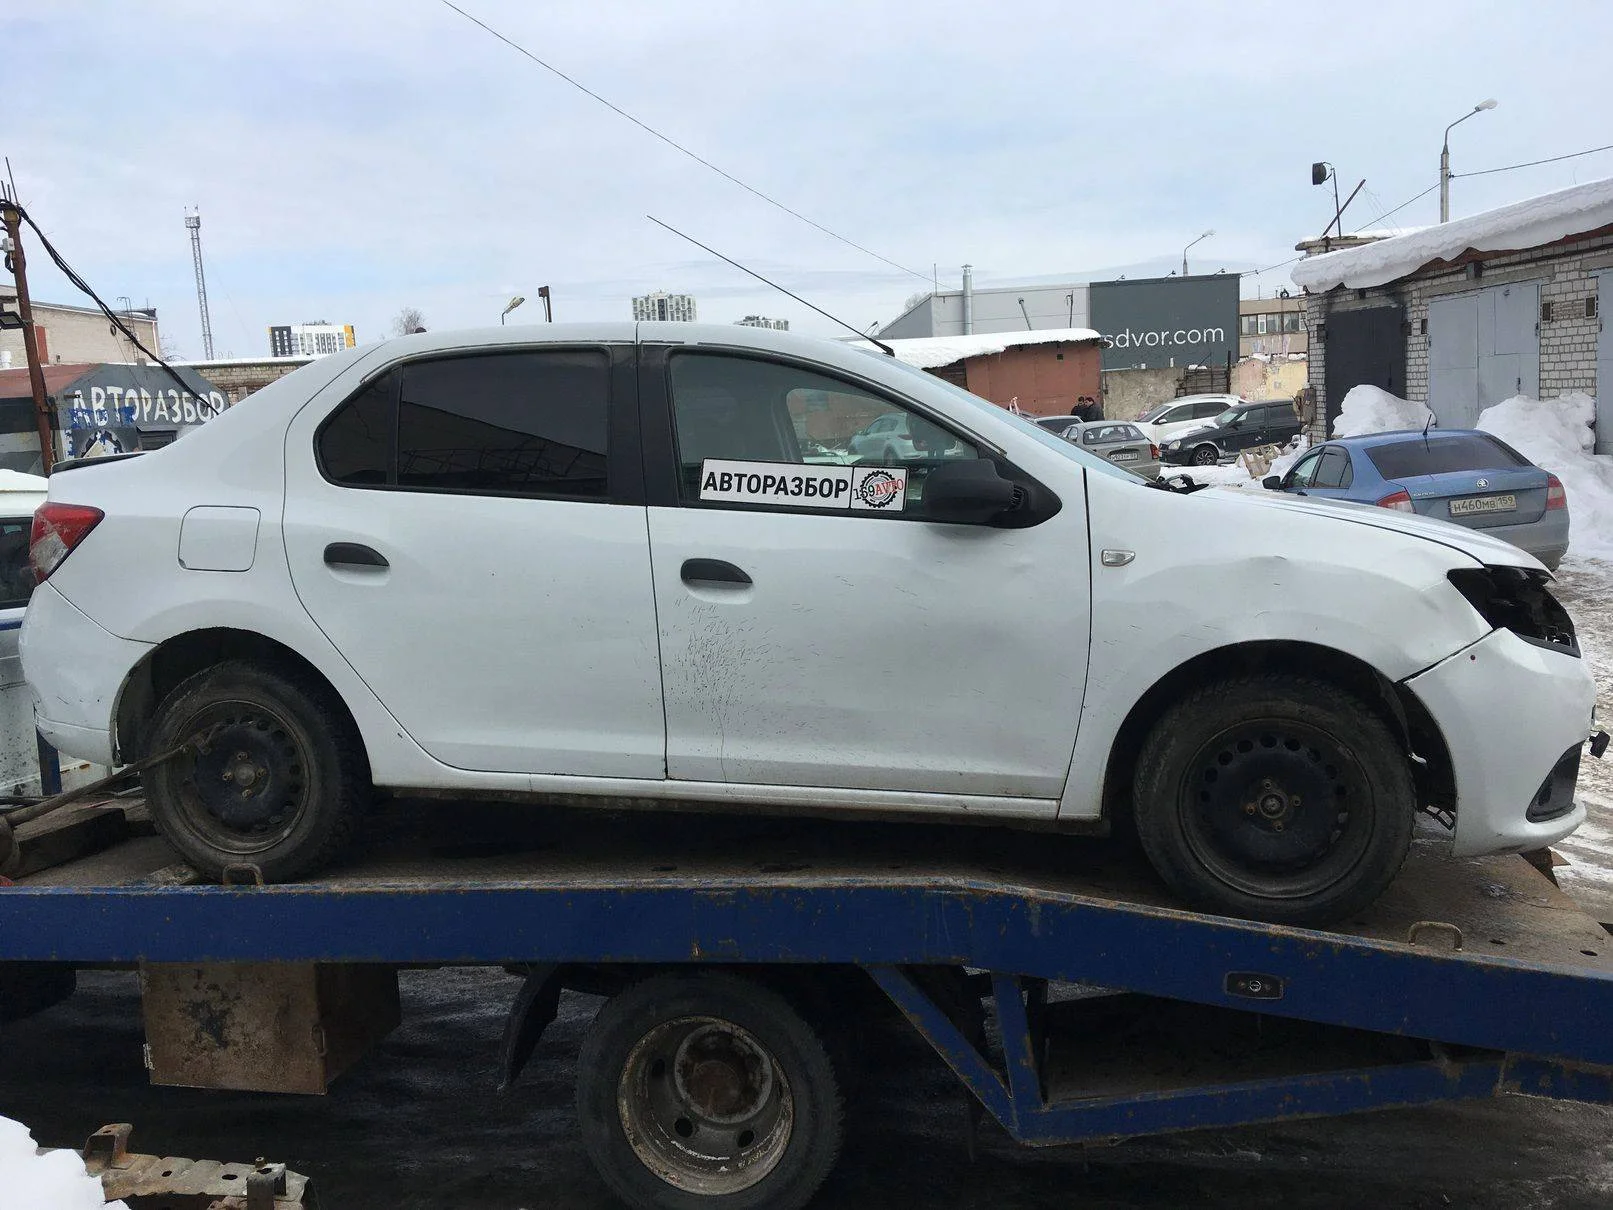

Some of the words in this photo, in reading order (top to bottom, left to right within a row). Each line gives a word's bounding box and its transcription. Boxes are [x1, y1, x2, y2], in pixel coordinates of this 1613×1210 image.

[1103, 327, 1224, 349] sdvor.com
[73, 386, 224, 427] АВТОРАЗБОР
[702, 471, 849, 499] АВТОРАЗБОР
